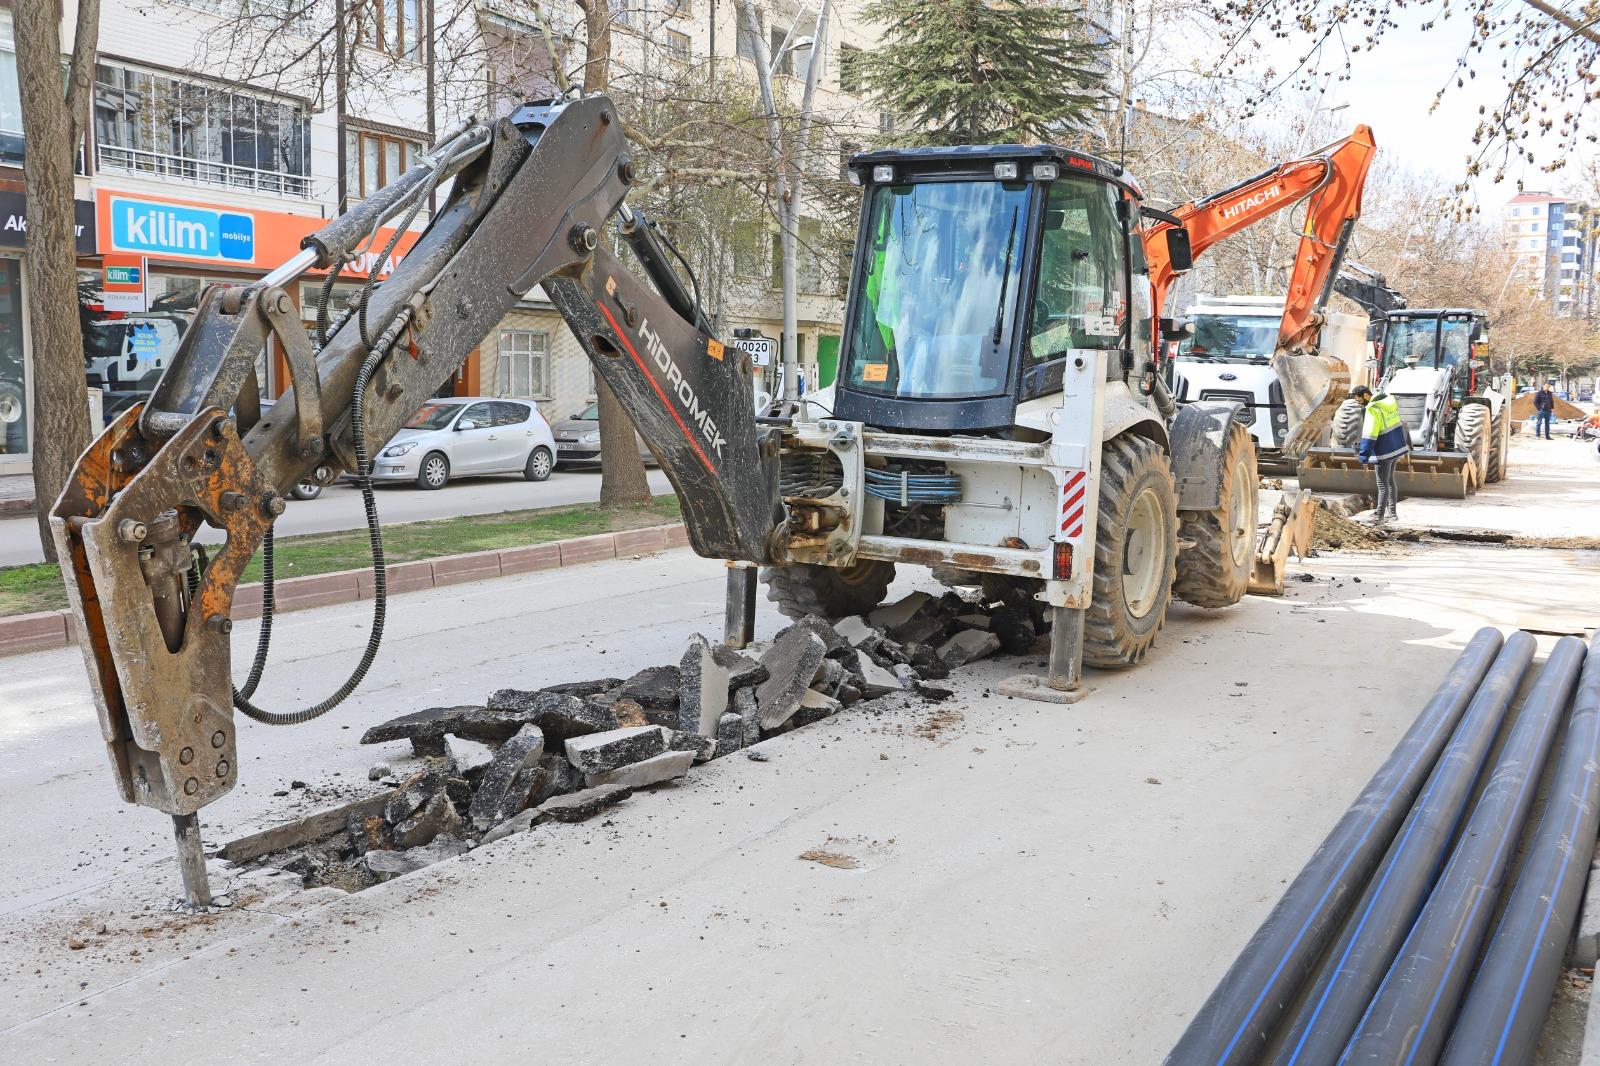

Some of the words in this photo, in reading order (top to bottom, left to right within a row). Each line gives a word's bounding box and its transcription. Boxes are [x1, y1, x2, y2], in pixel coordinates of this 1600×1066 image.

[1224, 185, 1280, 219] HITACHI
[127, 208, 208, 250] kilim
[222, 231, 251, 243] mobilya
[107, 269, 128, 281] kilim
